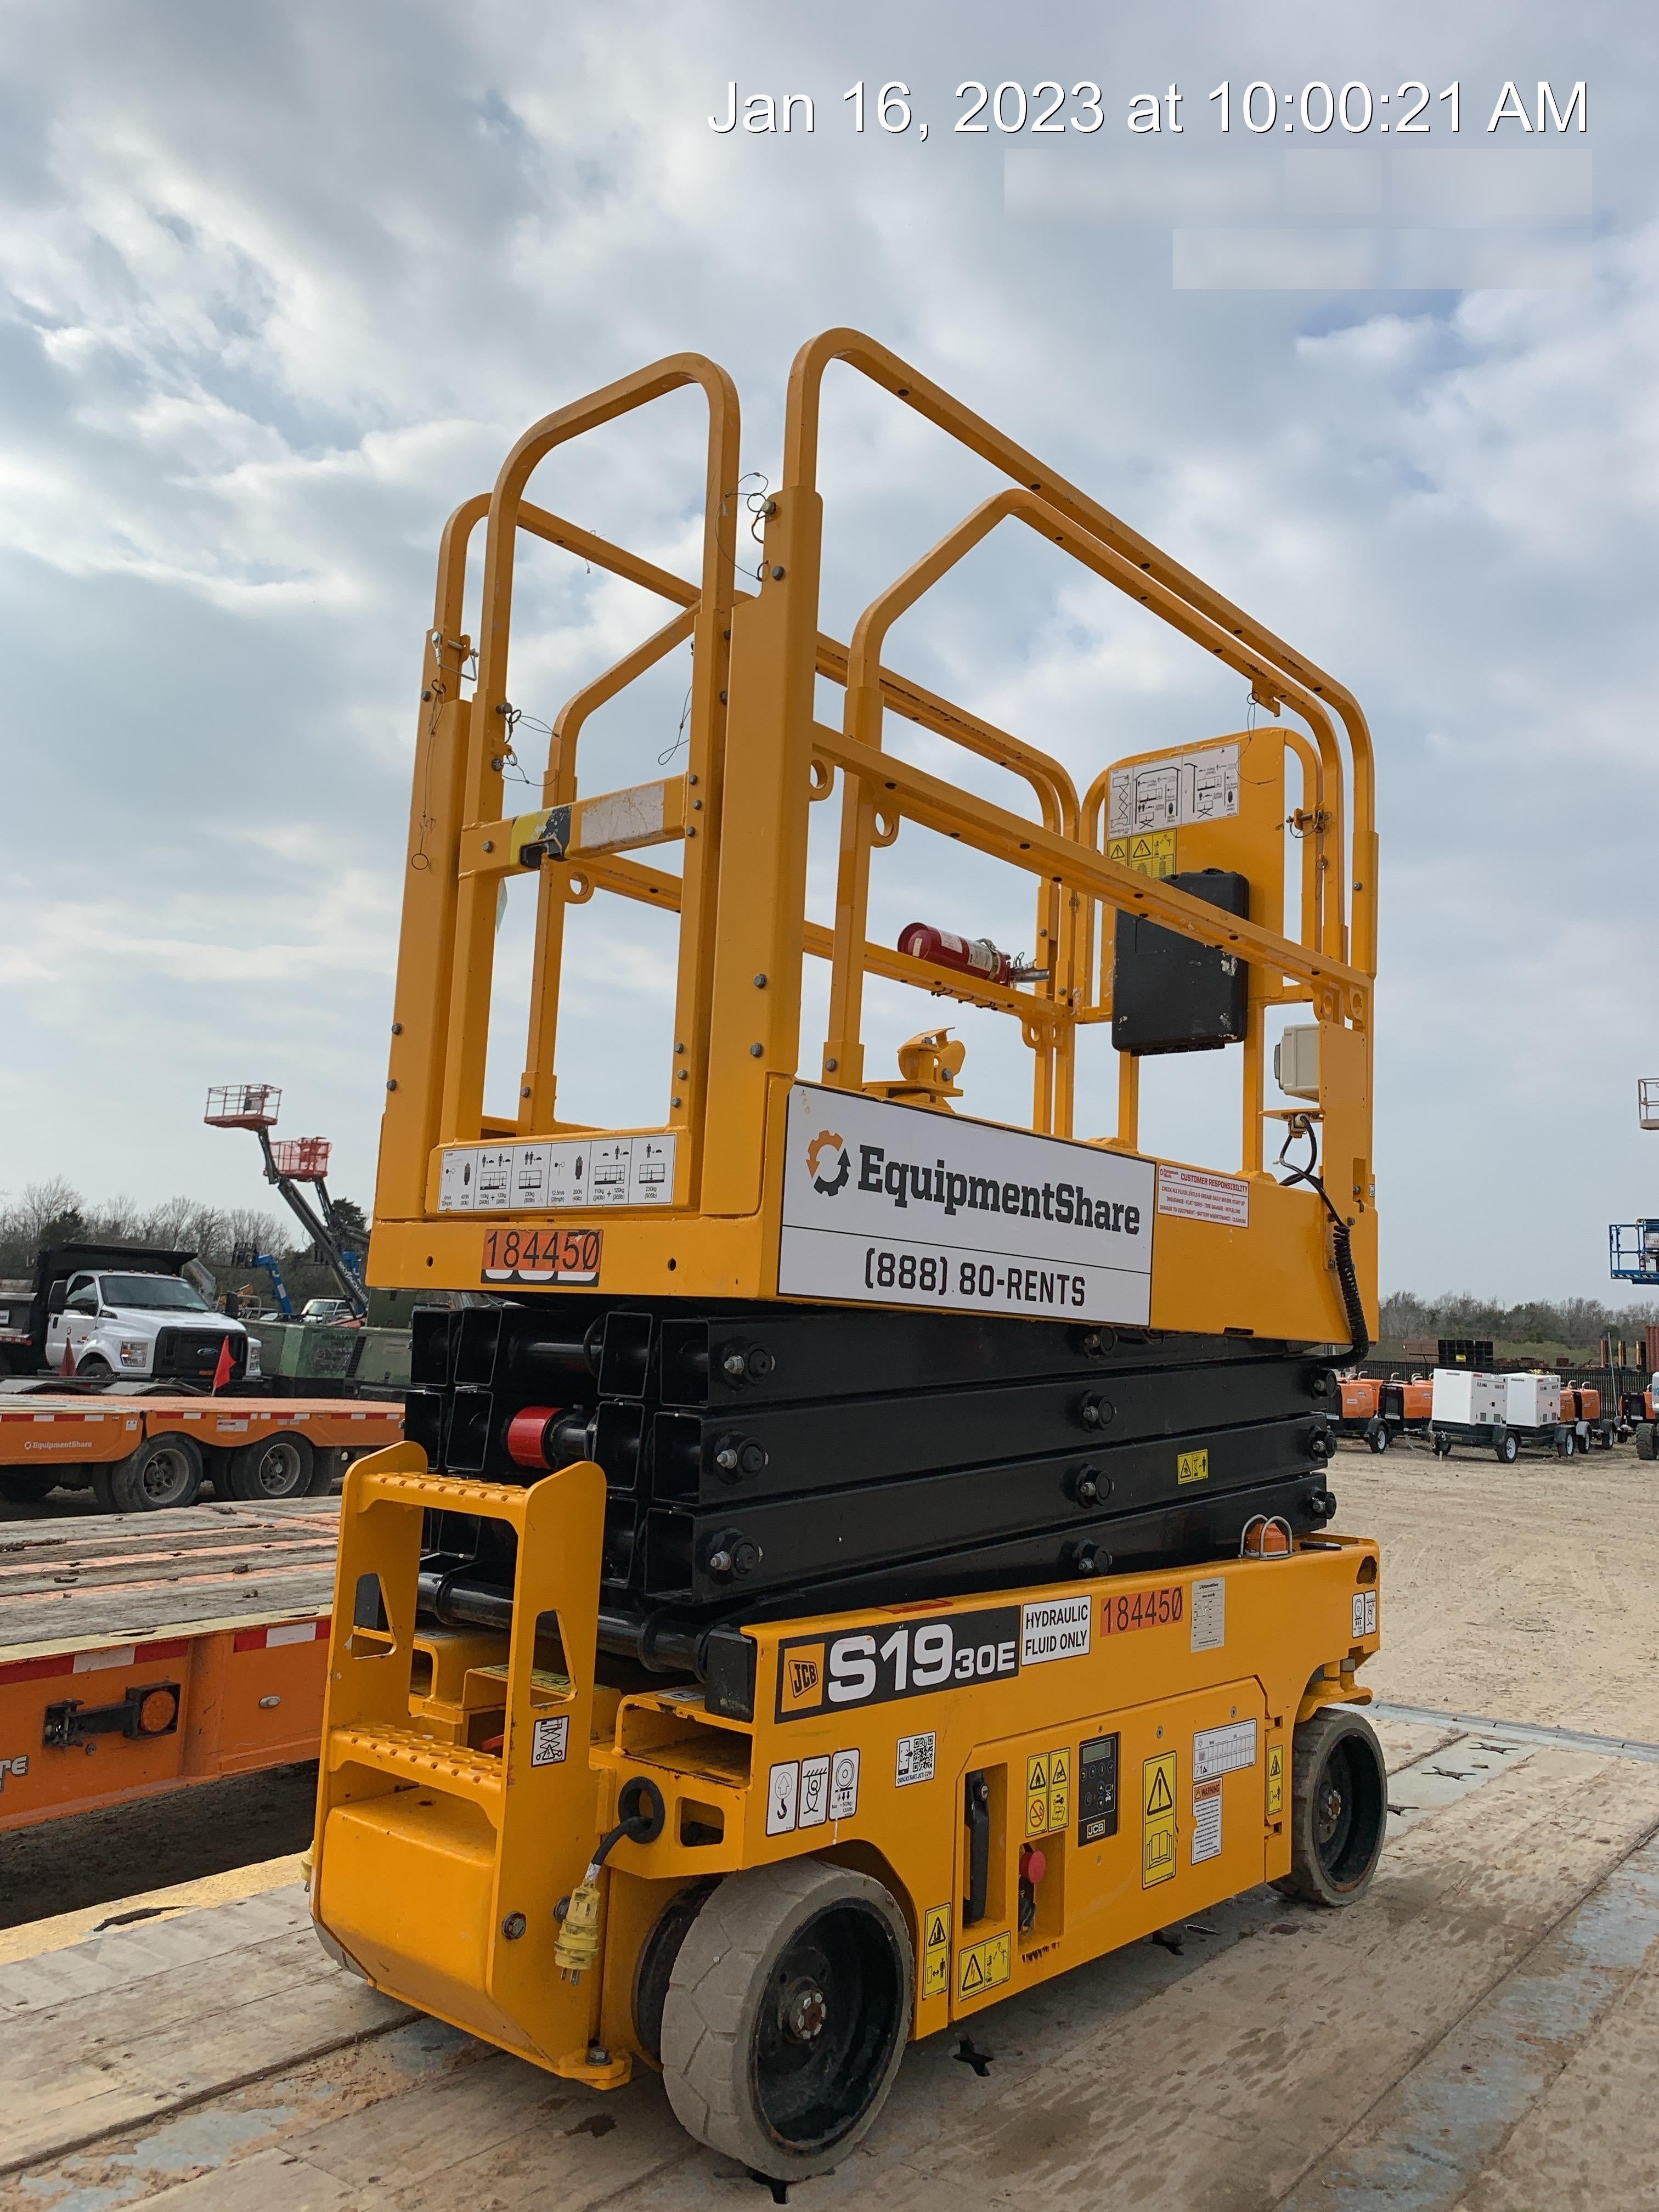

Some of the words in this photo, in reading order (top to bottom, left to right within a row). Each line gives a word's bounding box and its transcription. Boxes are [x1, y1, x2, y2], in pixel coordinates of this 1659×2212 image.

[858, 1144, 1141, 1235] EquipmentShare
[1181, 1173, 1207, 1185] CUSTOMER
[1209, 1178, 1248, 1193] RESPONSIBILITY
[487, 1231, 600, 1270] 184450
[865, 1248, 947, 1296] (888)
[959, 1262, 1085, 1307] 80-RENTS
[32, 1441, 92, 1450] EquipmentShare
[1026, 1604, 1088, 1629] HYDRAULIC
[1103, 1587, 1182, 1633] 184450
[1025, 1635, 1057, 1656] FLUID
[1060, 1629, 1087, 1650] ONLY
[793, 1663, 816, 1694] JCB
[897, 1770, 933, 1785] QUICKSTART.JCB.COM
[1201, 1784, 1220, 1796] WARNING
[1088, 1822, 1104, 1836] JCB
